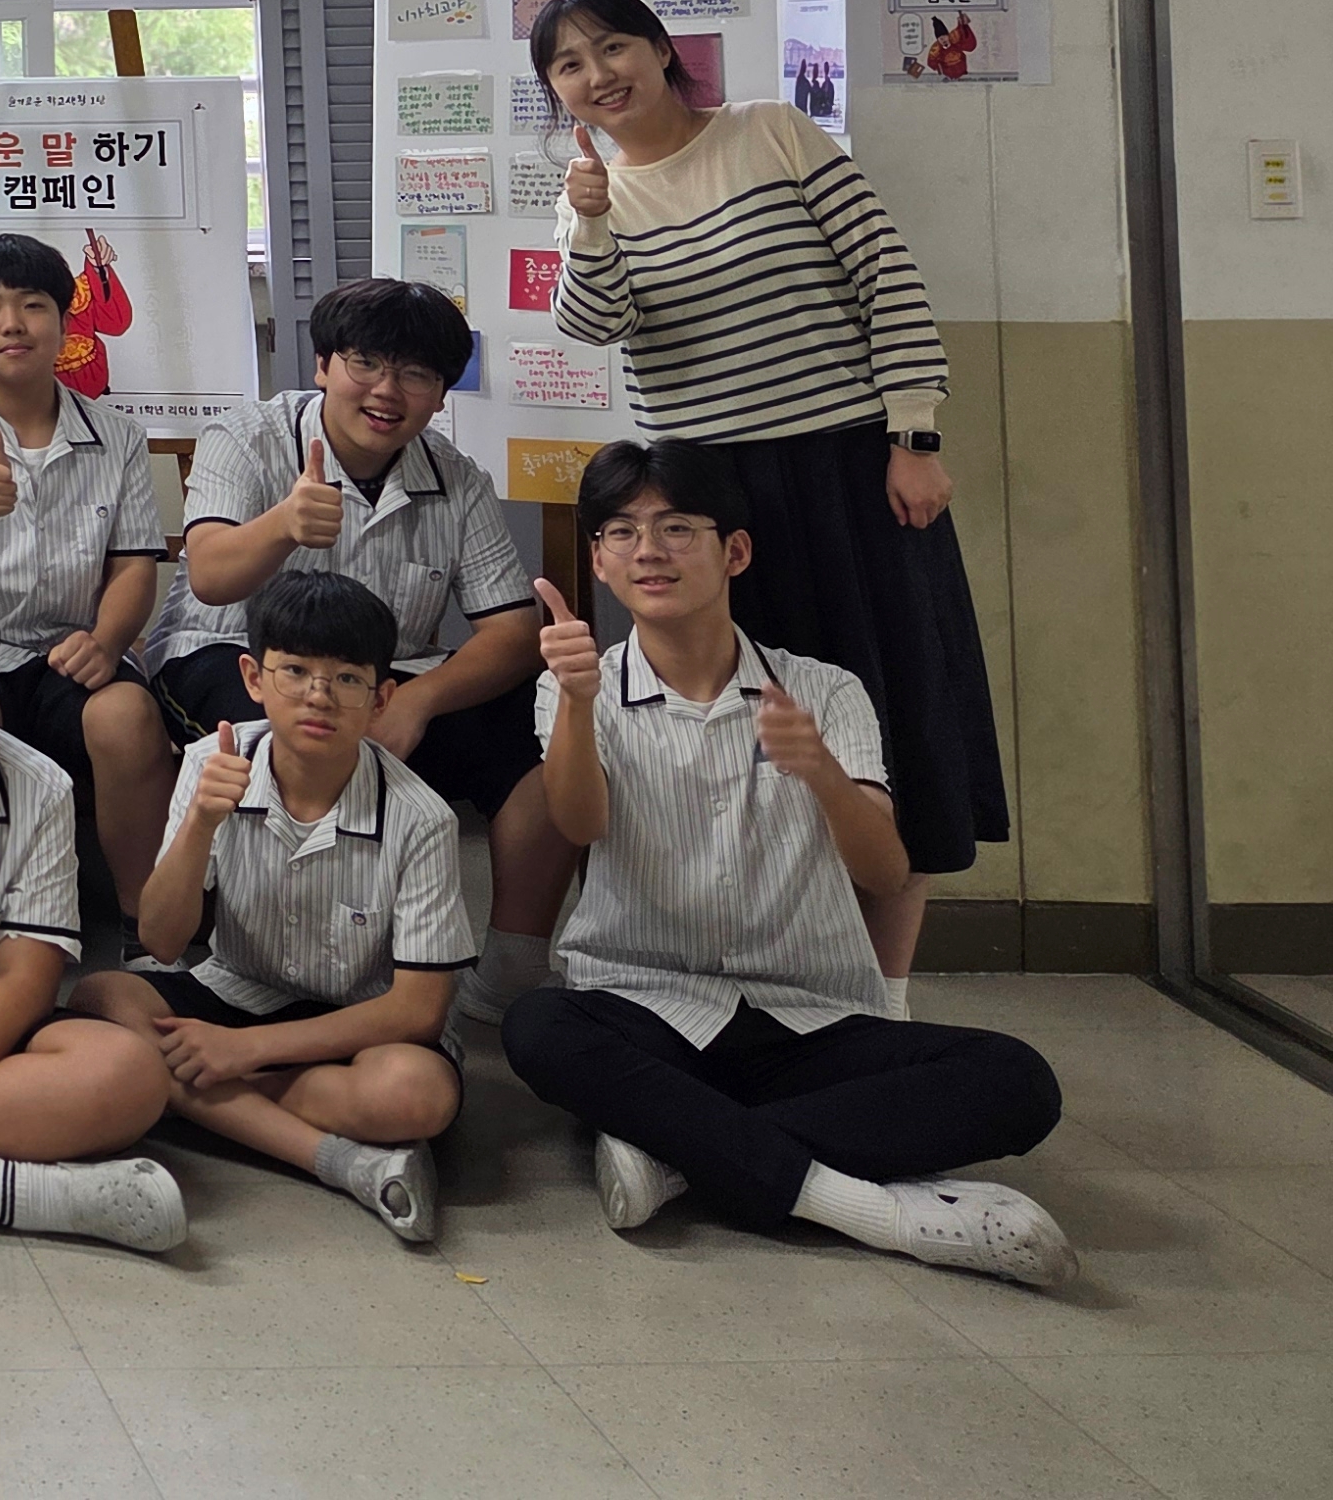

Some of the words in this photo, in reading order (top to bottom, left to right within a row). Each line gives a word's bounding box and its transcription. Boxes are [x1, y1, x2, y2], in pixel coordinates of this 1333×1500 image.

[42, 131, 77, 167] 말
[92, 130, 168, 167] 하기
[4, 174, 116, 210] 캠페인
